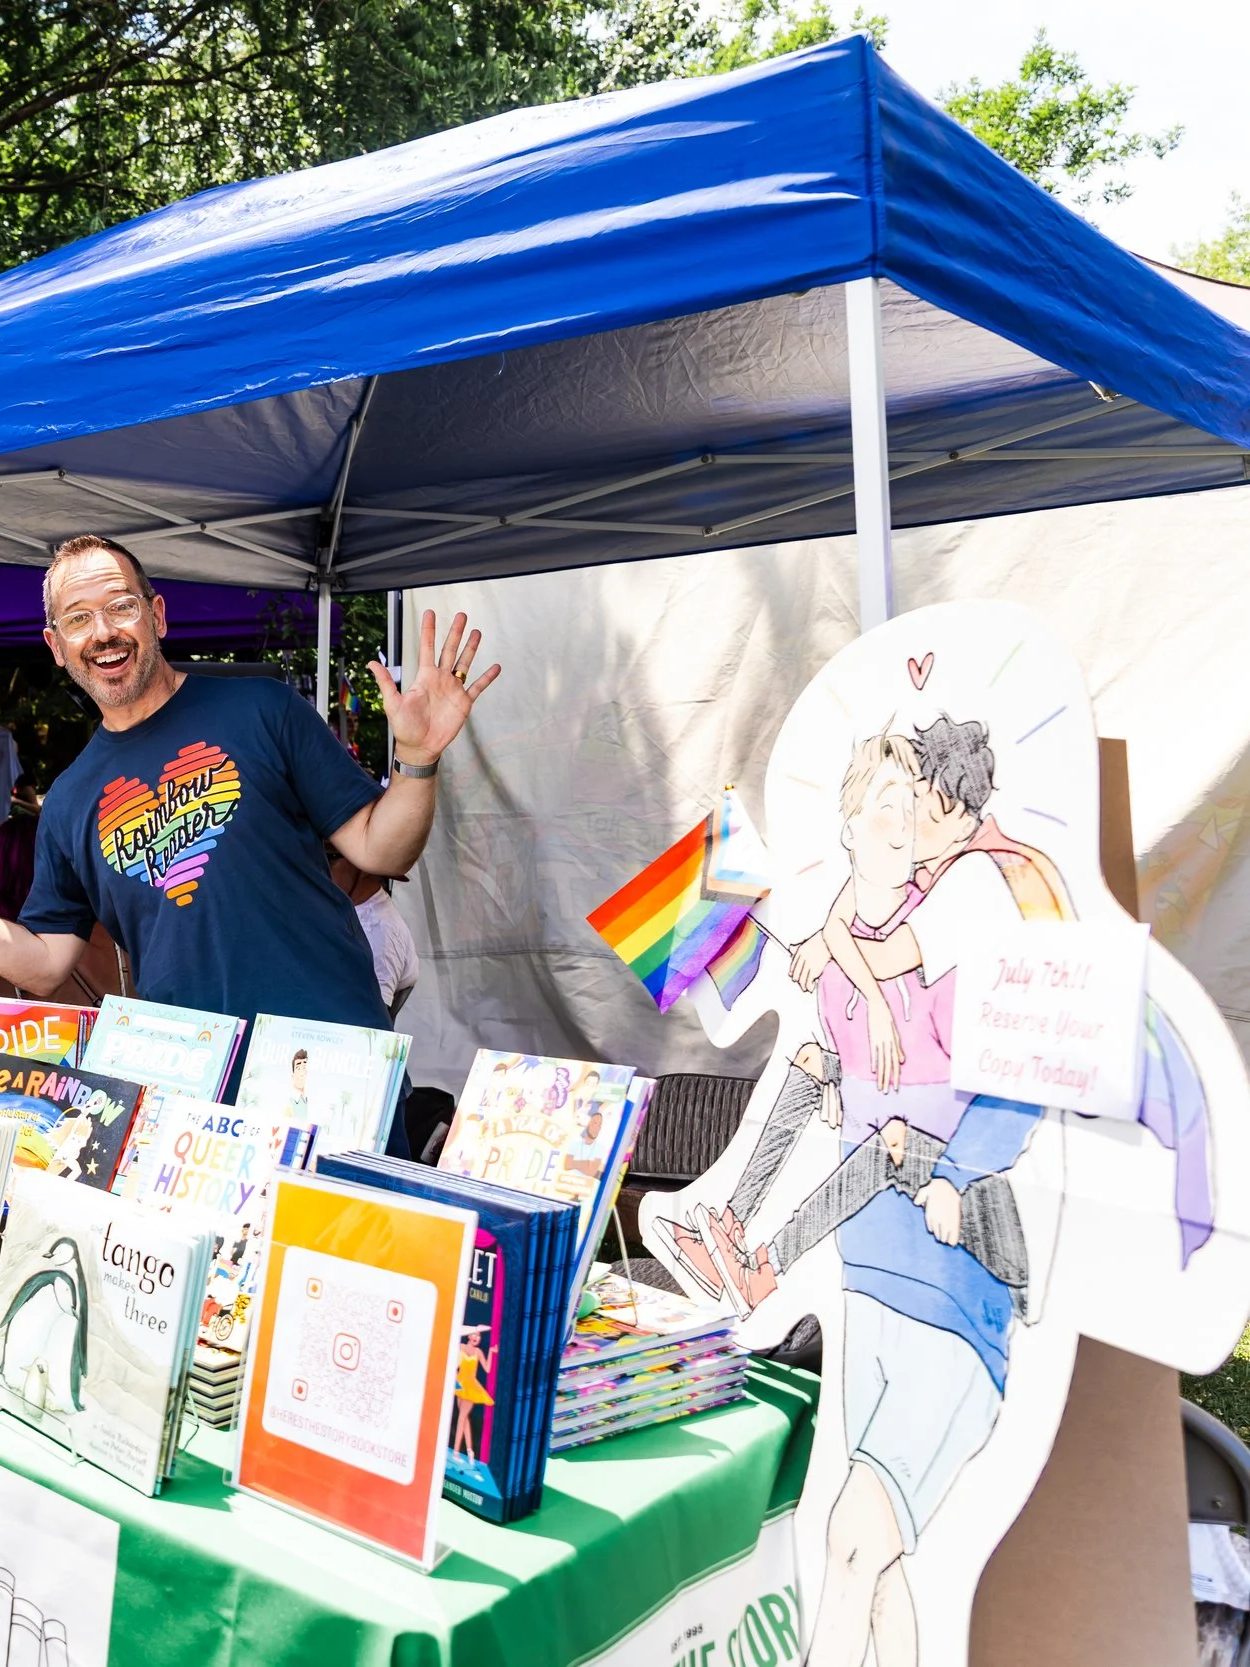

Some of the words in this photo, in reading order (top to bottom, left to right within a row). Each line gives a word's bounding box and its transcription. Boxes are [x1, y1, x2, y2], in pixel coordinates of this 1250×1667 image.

[114, 753, 230, 874] Rainbow
[144, 797, 240, 887] Reader
[991, 957, 1035, 994] July
[291, 1031, 314, 1041] STEVEN
[978, 1001, 1049, 1034] Reserve
[1055, 1009, 1105, 1045] Your
[101, 1030, 213, 1082] PRIDE
[310, 1048, 376, 1079] GUNCLE
[978, 1048, 1025, 1086] Copy
[1031, 1054, 1099, 1098] Today!
[11, 1070, 24, 1089] A
[187, 1112, 202, 1125] THE
[249, 1127, 261, 1137] OF
[174, 1131, 256, 1179] QUEER
[153, 1163, 256, 1215] HISTORY
[102, 1221, 175, 1294] tango
[103, 1270, 136, 1294] makes
[124, 1295, 168, 1334] three
[269, 1404, 410, 1468] @HERESTHESTORYBOOKSTORE
